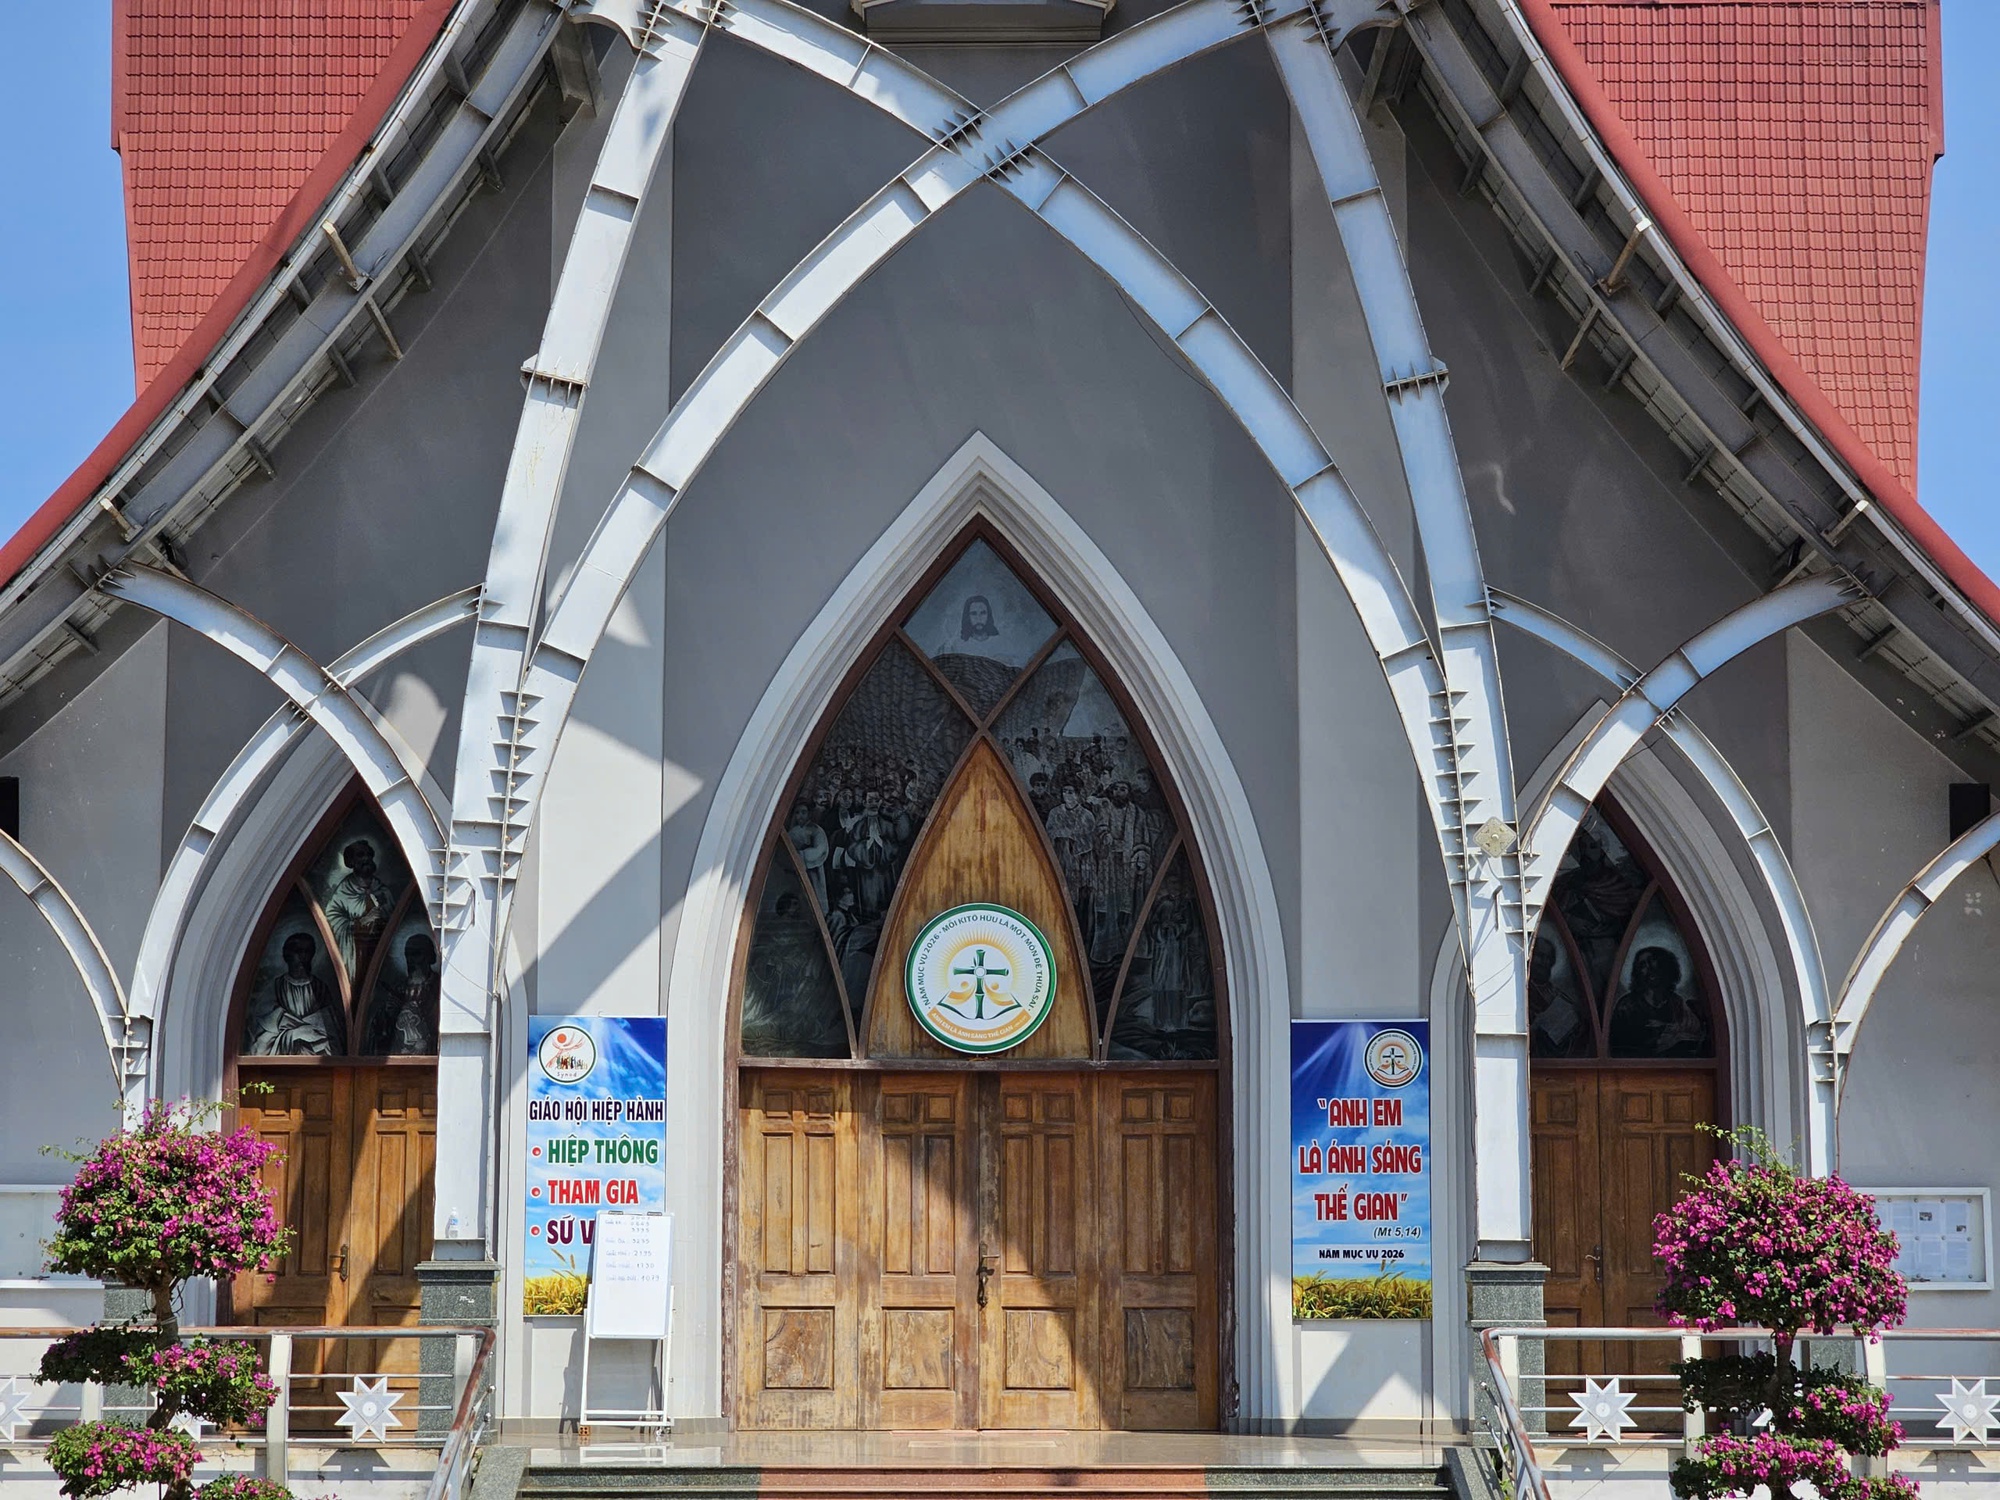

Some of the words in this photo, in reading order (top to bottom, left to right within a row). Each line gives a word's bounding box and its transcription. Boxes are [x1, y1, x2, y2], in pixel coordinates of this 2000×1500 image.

[924, 934, 939, 953] 2026
[1028, 995, 1039, 1008] SAI
[530, 1096, 560, 1120] GIÁO
[566, 1097, 587, 1125] HỘI
[592, 1097, 622, 1125] HIỆP
[626, 1096, 663, 1120] HÀNH
[1374, 1099, 1401, 1126] EM
[548, 1134, 589, 1166] HIỆP
[594, 1134, 658, 1164] THÔNG
[1300, 1141, 1321, 1173] LÀ
[1328, 1140, 1365, 1173] ÁNH
[1372, 1140, 1421, 1173] SÁNG
[548, 1180, 600, 1204] THAM
[606, 1180, 638, 1204] GIA
[1315, 1184, 1347, 1220] THẾ
[547, 1215, 575, 1244] SỨ
[580, 1220, 595, 1244] V
[1374, 1228, 1391, 1238] (Mt
[1395, 1228, 1421, 1238] 5,14)
[1343, 1250, 1363, 1260] MỤC
[1366, 1250, 1378, 1260] VỤ
[1381, 1250, 1404, 1258] 2026
